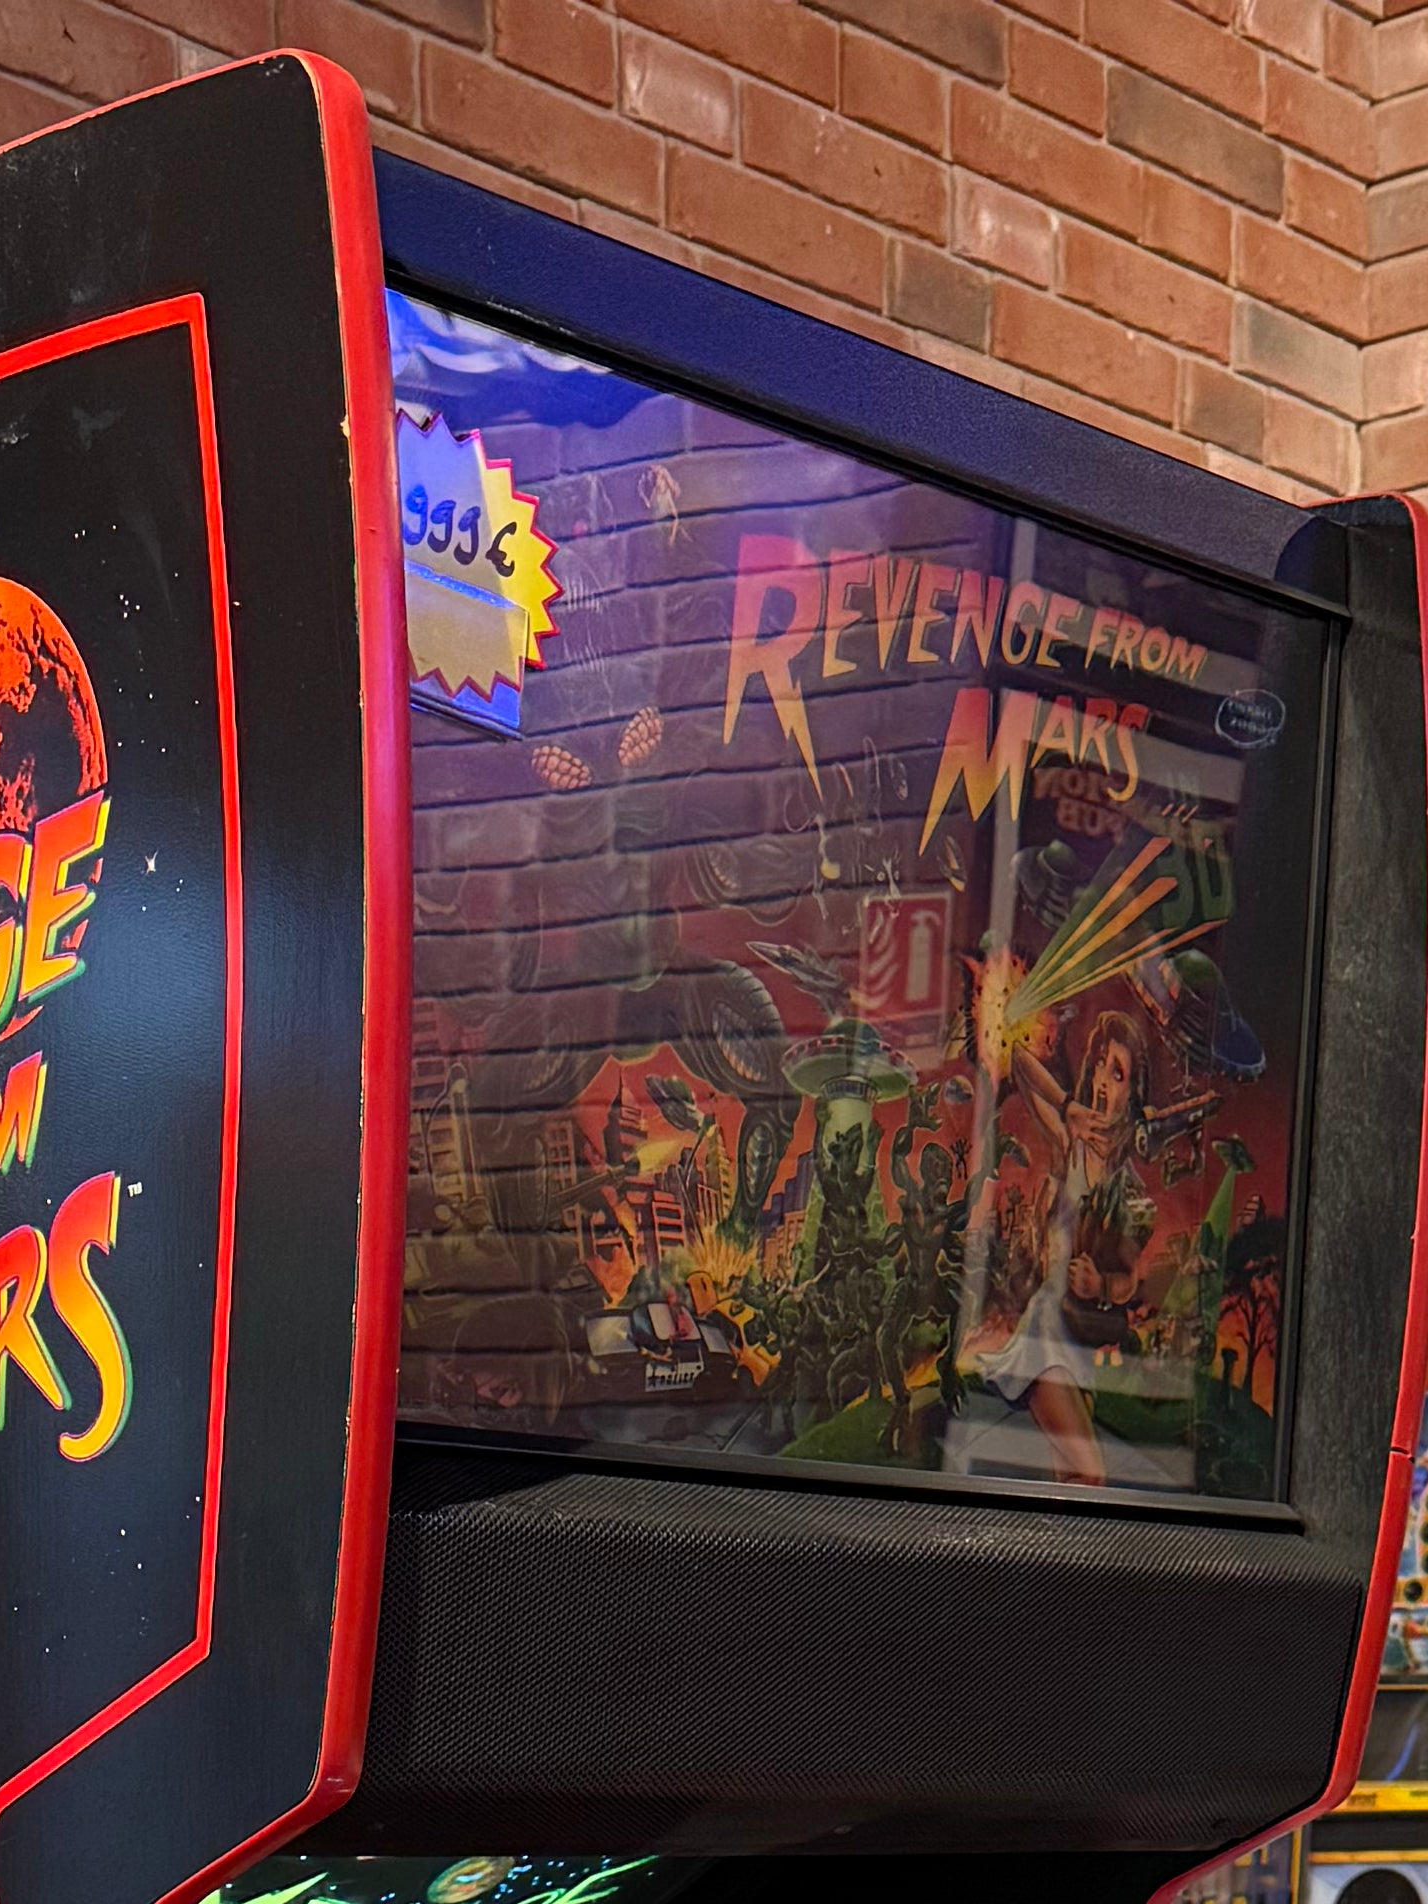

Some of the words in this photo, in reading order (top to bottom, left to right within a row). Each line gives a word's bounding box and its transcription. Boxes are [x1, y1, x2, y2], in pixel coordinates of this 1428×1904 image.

[723, 534, 1085, 801] REVENGE
[1085, 606, 1209, 681] FROM
[918, 686, 1150, 857] MARS
